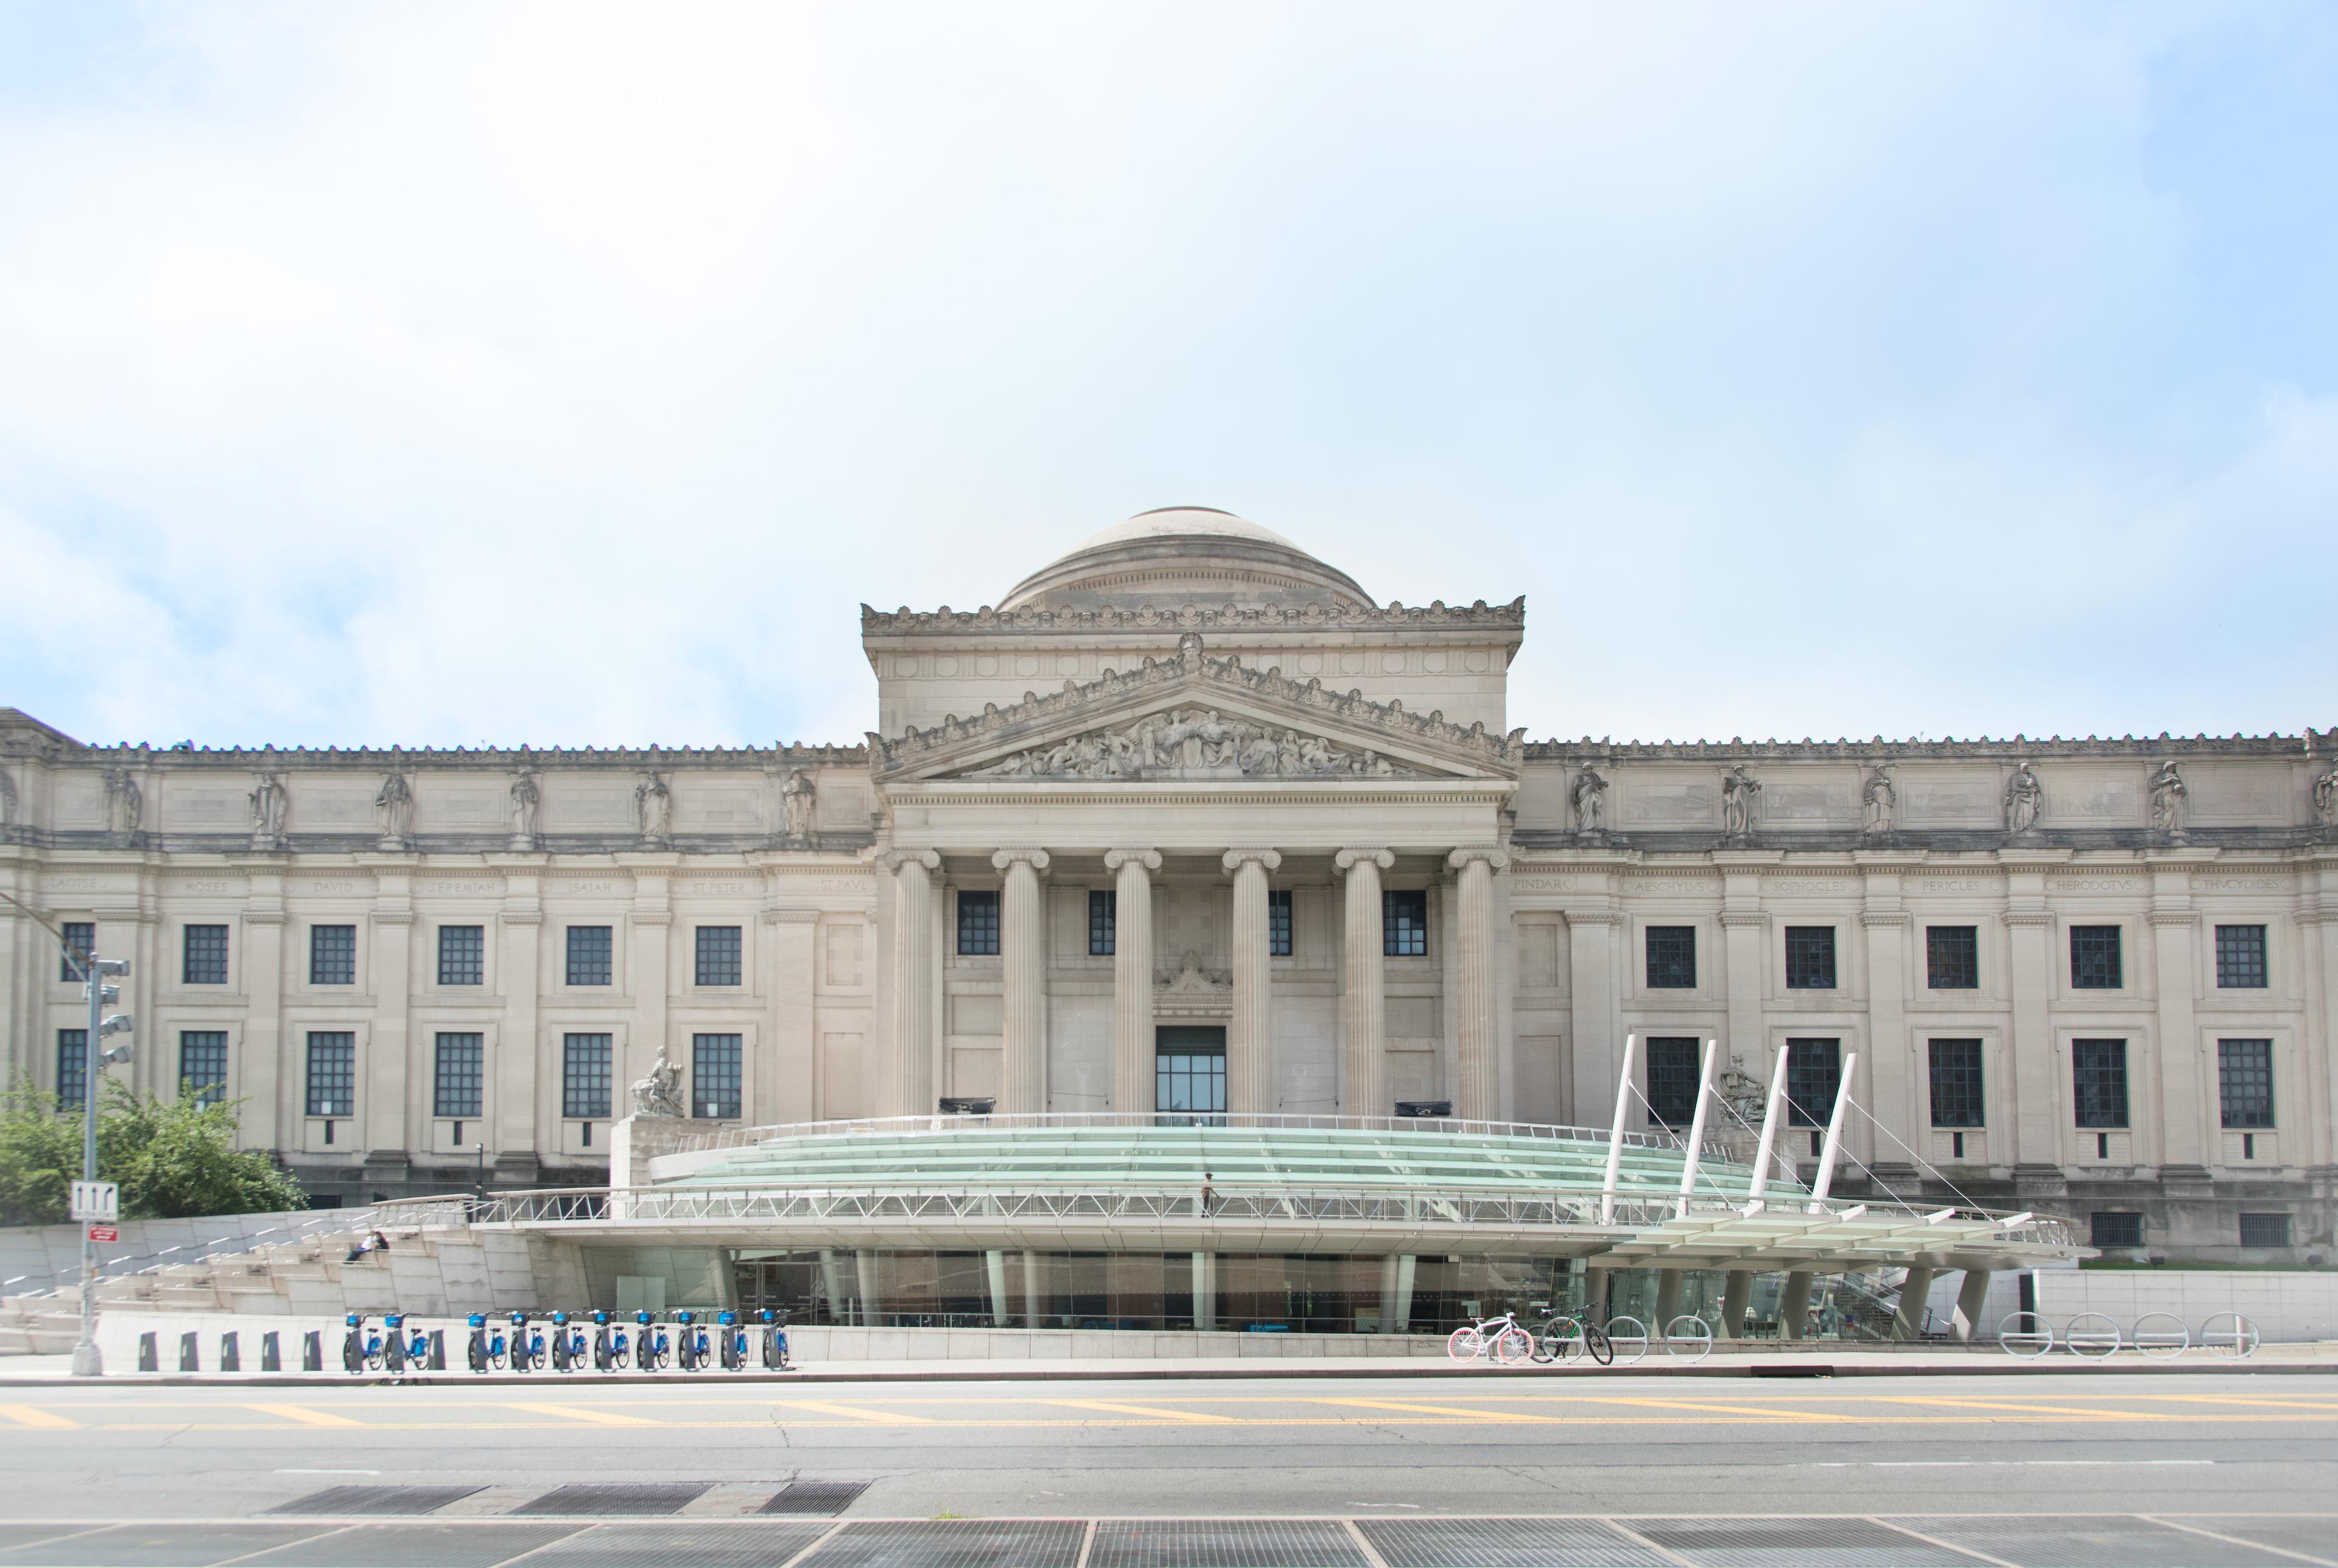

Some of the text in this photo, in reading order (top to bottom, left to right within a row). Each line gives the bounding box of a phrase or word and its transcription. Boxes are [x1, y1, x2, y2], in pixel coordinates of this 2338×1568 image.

[185, 883, 228, 892] MOSES
[314, 883, 353, 892] DAVID
[429, 883, 494, 892] JEREMIAH
[570, 883, 611, 892] ISAIAH
[1514, 880, 1562, 889] PINDAR
[1635, 882, 1704, 892] AESCHYLVS
[1774, 882, 1846, 891] SOPHOCLES
[1923, 881, 1979, 891] PERICLES
[2057, 881, 2133, 891] HERODOTVS
[2202, 880, 2280, 889] THVCYDIDES
